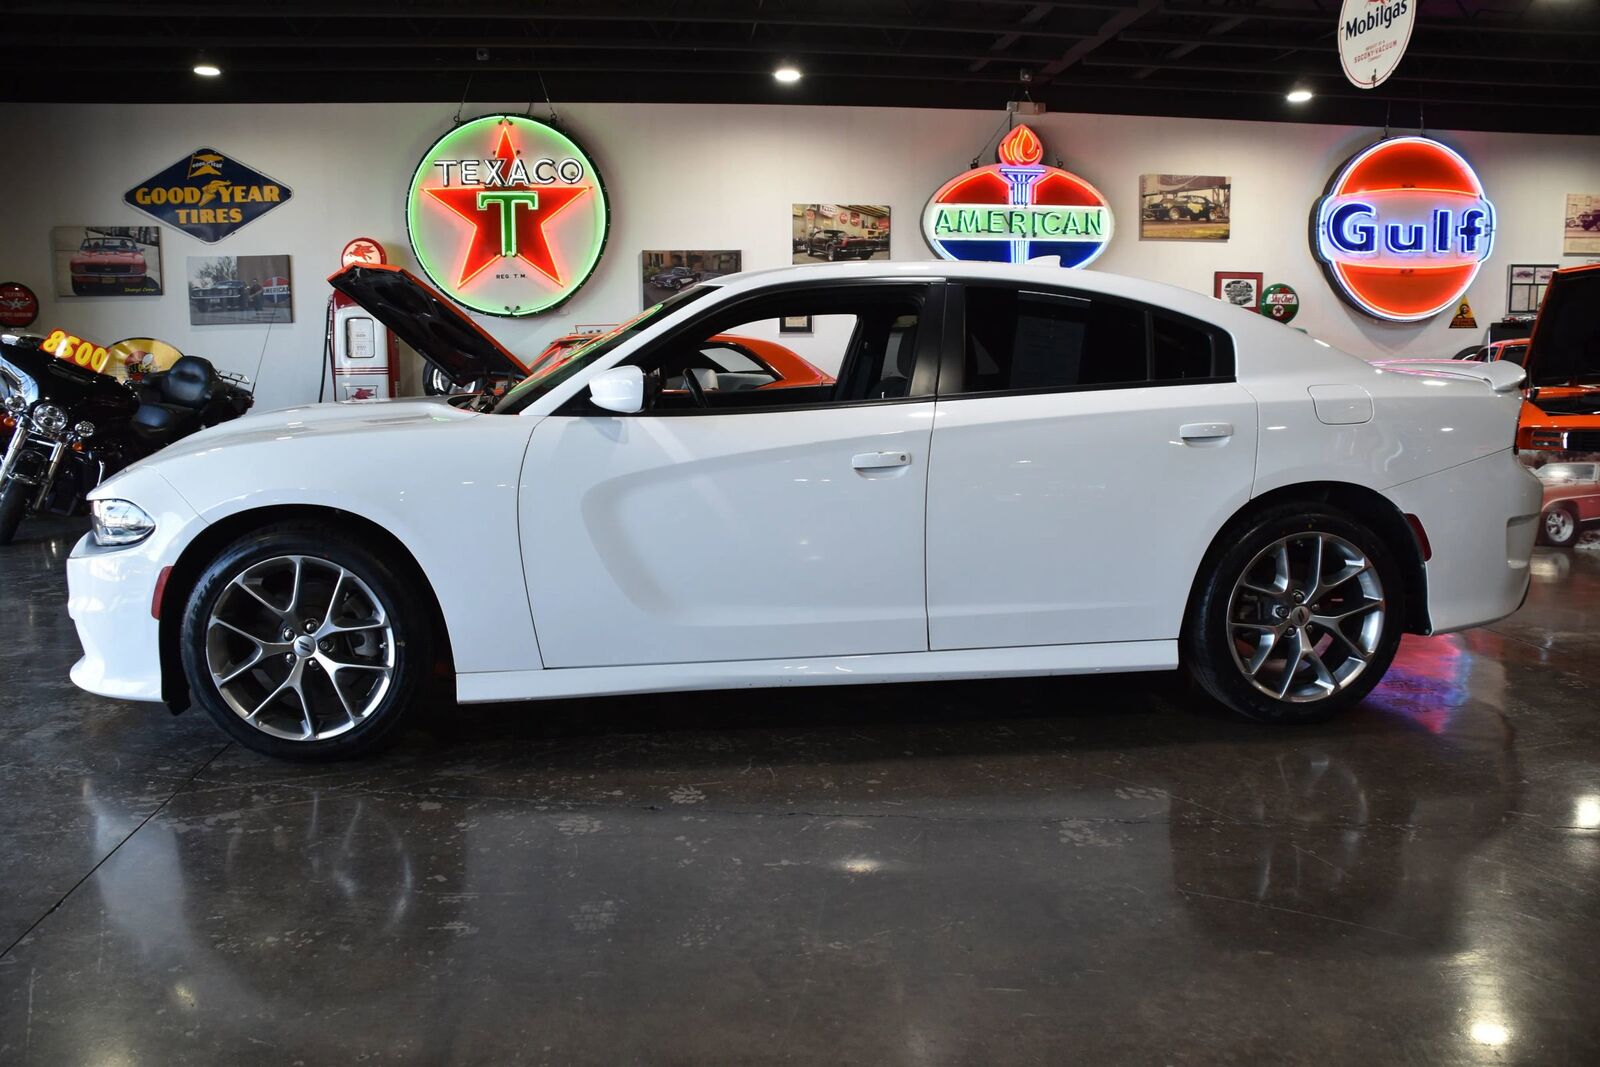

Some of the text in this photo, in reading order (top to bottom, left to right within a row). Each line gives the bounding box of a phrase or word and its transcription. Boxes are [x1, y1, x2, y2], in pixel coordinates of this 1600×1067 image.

[1345, 0, 1407, 40] Mobilgas
[434, 158, 584, 187] TEXACO
[175, 208, 243, 224] TIRES
[476, 191, 539, 257] T
[935, 209, 1104, 236] AMERICAN
[1327, 201, 1487, 253] Gulf
[43, 330, 108, 371] 8500
